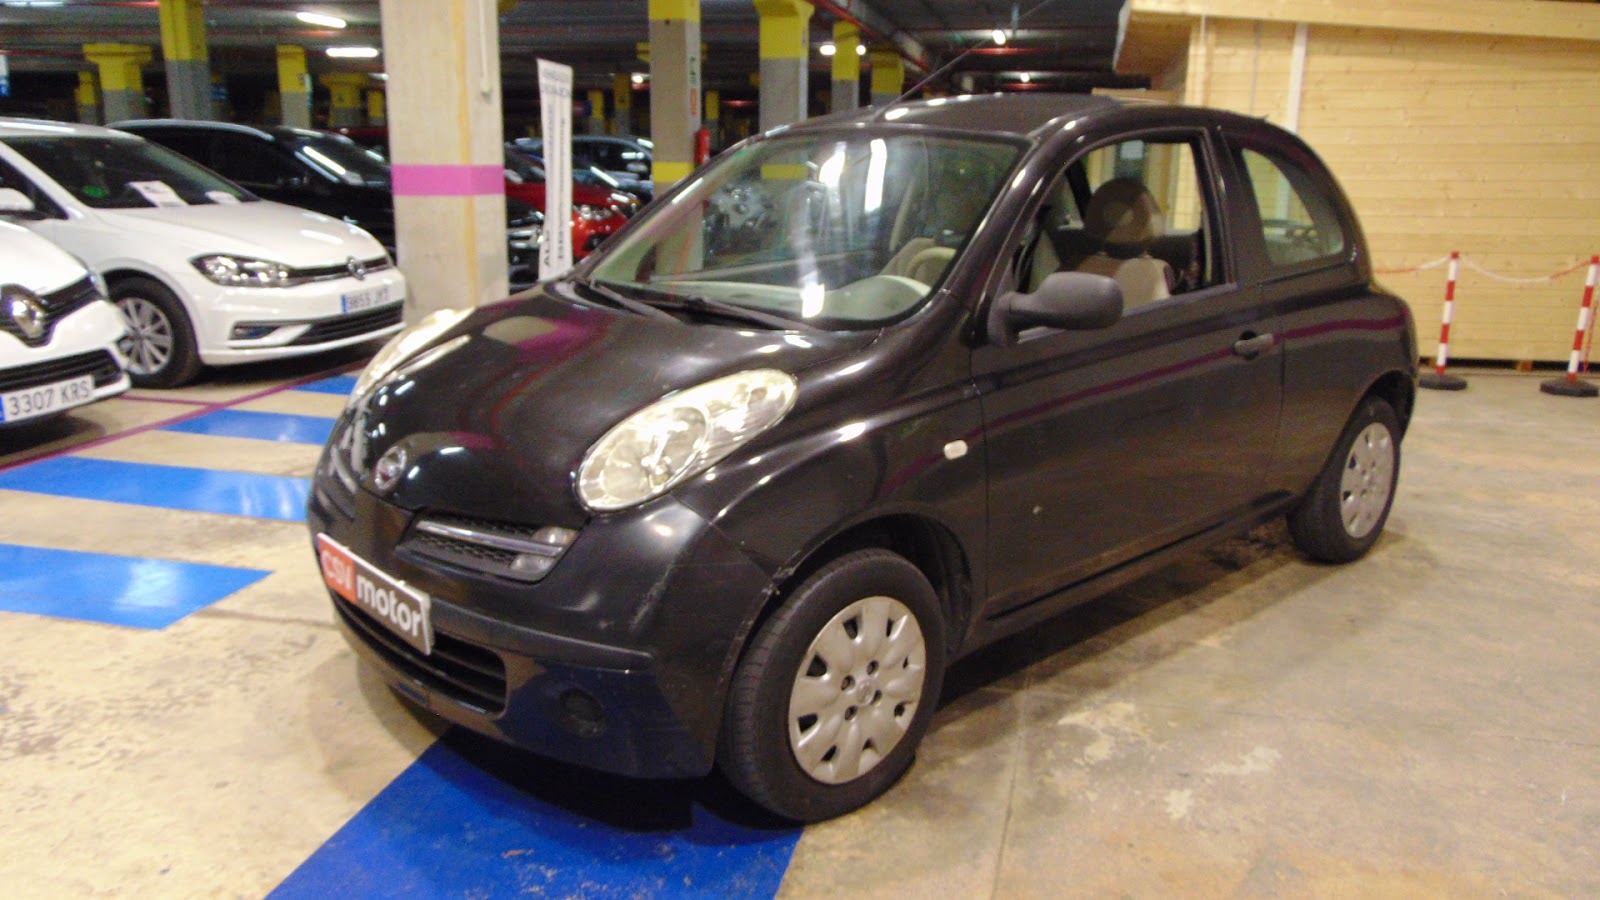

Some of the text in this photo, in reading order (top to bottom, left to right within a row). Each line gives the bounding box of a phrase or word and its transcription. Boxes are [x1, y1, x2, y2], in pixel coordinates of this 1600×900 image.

[8, 380, 90, 416] 3307 KRS
[356, 574, 422, 637] motor
